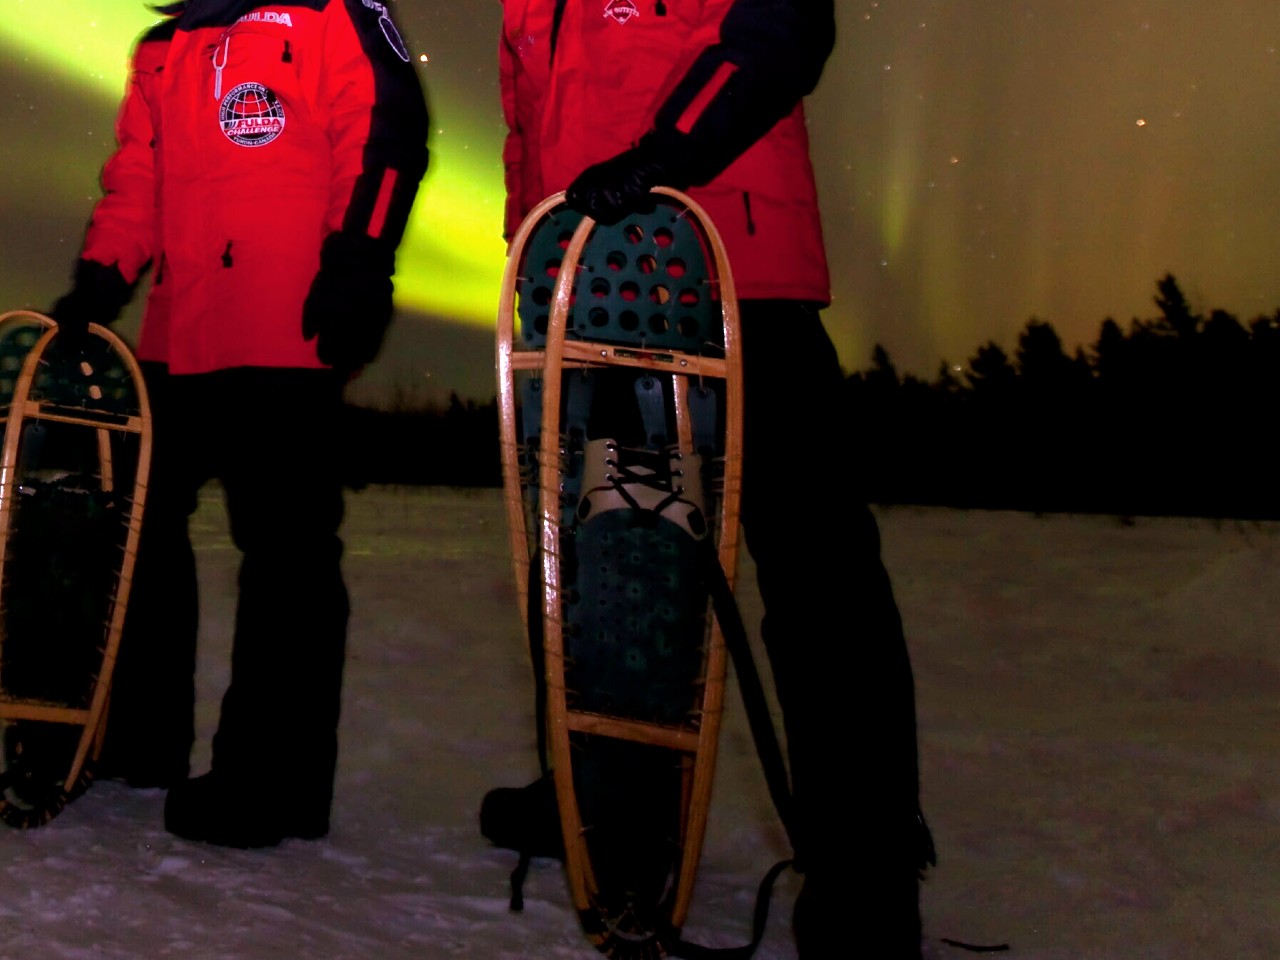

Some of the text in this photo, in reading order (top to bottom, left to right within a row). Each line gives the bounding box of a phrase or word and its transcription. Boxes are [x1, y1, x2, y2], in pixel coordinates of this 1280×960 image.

[239, 11, 293, 28] ULDA
[223, 84, 258, 106] PERFORMANCE
[236, 118, 282, 129] FULDA
[227, 126, 280, 136] CHALLENGE
